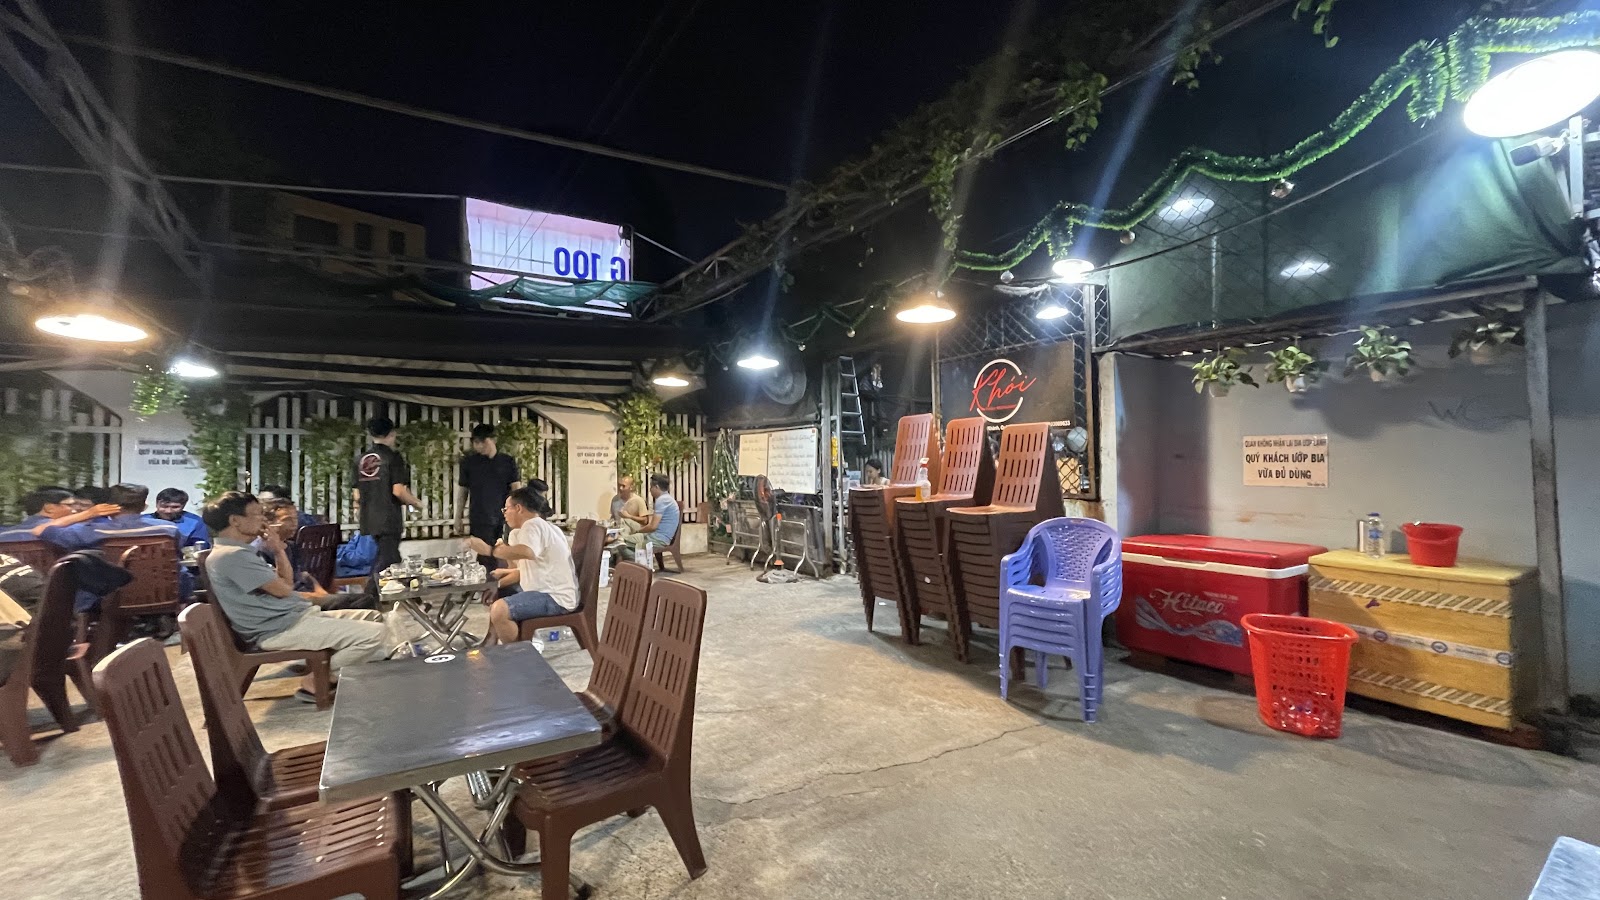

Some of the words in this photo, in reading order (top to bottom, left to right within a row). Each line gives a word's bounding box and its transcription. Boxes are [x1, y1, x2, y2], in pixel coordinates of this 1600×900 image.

[970, 367, 1037, 412] Khói
[1246, 452, 1260, 463] QUÝ
[1263, 451, 1289, 463] KHÁCH
[1292, 450, 1309, 463] ƯỚP
[1311, 453, 1325, 463] BIA
[1257, 467, 1272, 478] VỪA
[1275, 466, 1285, 478] ĐỦ
[1289, 467, 1311, 479] DÙNG
